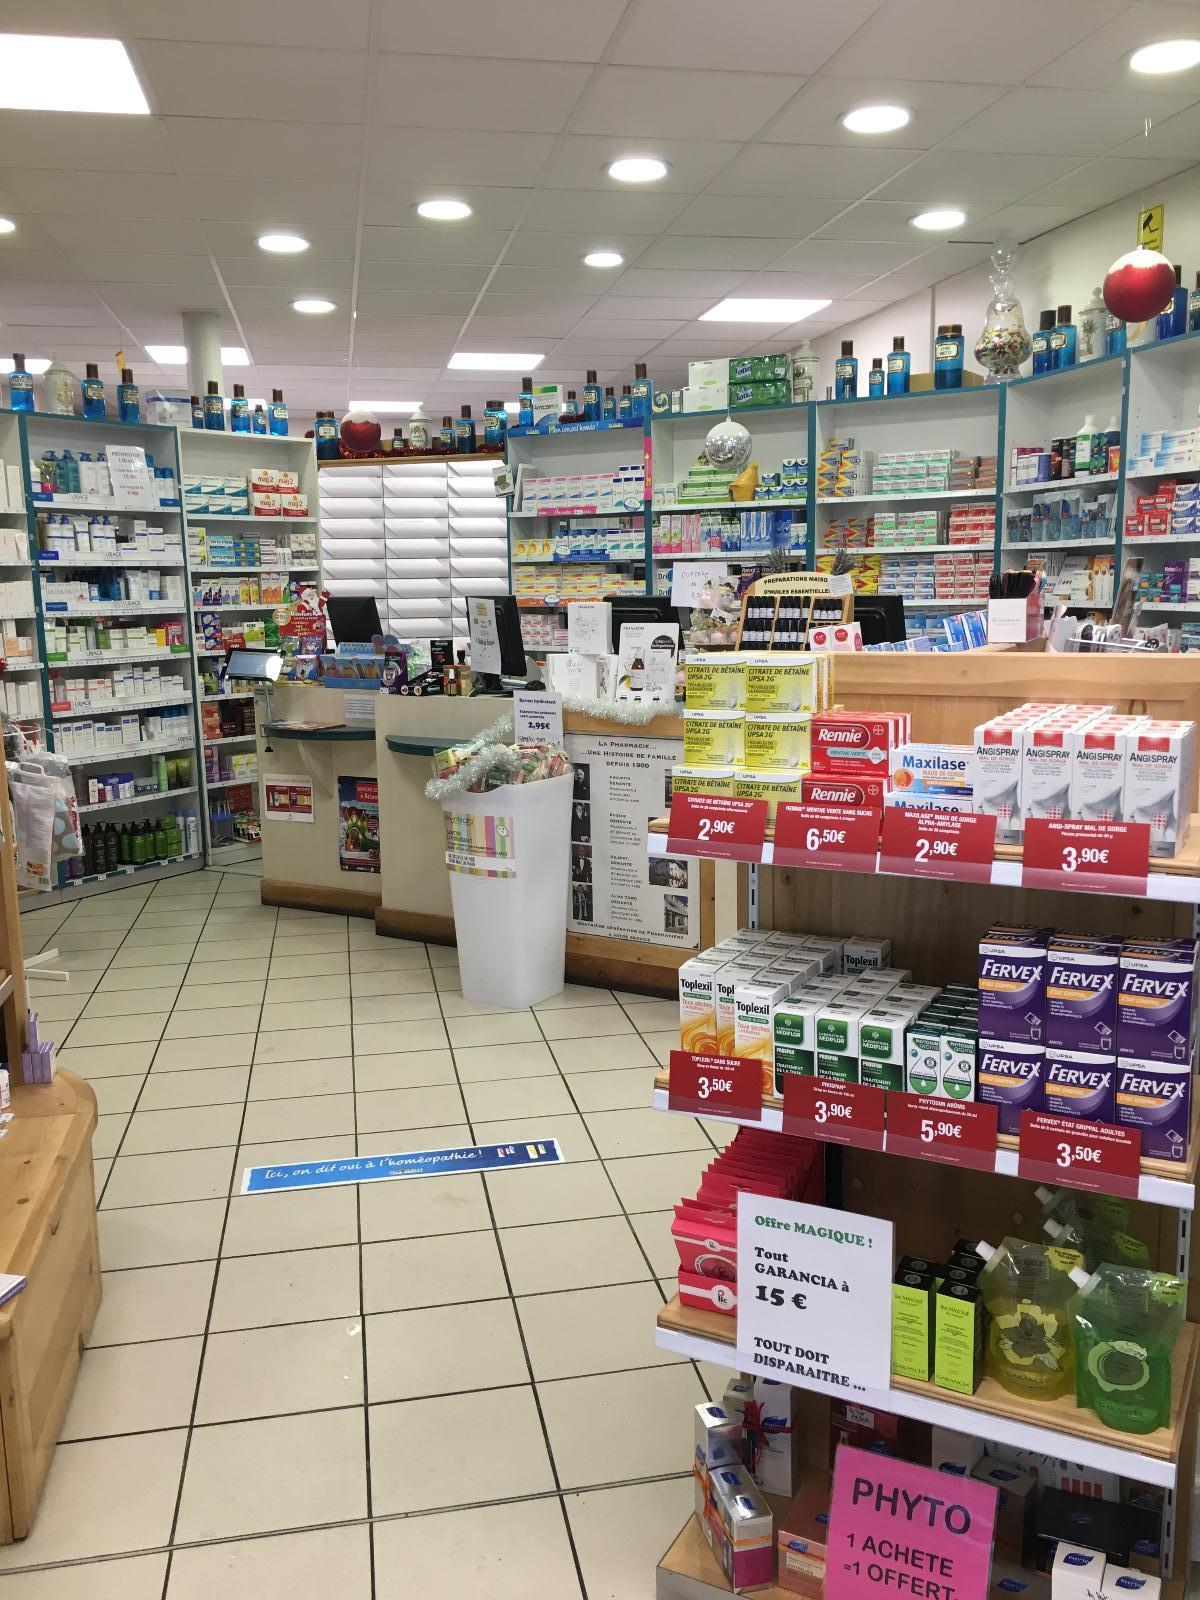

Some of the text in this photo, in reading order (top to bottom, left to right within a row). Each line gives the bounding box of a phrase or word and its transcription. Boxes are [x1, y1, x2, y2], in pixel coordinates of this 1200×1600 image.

[764, 576, 808, 584] PREPARATIONS
[688, 666, 710, 674] CITRATE
[528, 722, 550, 730] 2,95€
[818, 729, 862, 743] Rennie
[977, 746, 1020, 756] ANGISPRAY
[1026, 748, 1071, 758] ANGISPRAY
[1076, 750, 1123, 761] ANGISPRAY
[1130, 753, 1178, 764] ANGISPRAY
[903, 755, 966, 771] Maxilase
[674, 778, 697, 787] CITRATE
[736, 783, 761, 791] CITRATE
[811, 788, 856, 803] Rennie
[959, 816, 978, 824] GORGE
[1048, 823, 1083, 831] ANGI-SPRAY
[698, 818, 736, 841] 2,90€
[806, 828, 847, 851] 6,50€
[914, 839, 959, 863] 2,90€
[1062, 846, 1110, 873] 3,90€
[845, 955, 879, 968] Toplexil
[982, 959, 1043, 984] FERVEX
[1050, 967, 1115, 992] FERVEX
[680, 979, 713, 992] Toplexil
[1122, 974, 1190, 1000] FERVEX
[736, 1001, 770, 1015] Toplexil
[982, 1054, 1042, 1080] FERVEX
[1049, 1064, 1112, 1090] FERVEX
[698, 1076, 733, 1099] 3,50€
[1120, 1073, 1186, 1100] FERVEX
[919, 1098, 946, 1107] PHYTOSUN
[814, 1101, 853, 1123] 3,90€
[921, 1119, 962, 1143] 5,90€
[1062, 1120, 1075, 1128] ÉTAT
[1076, 1123, 1100, 1133] GRIPPAL
[1100, 1128, 1126, 1137] ADULTES
[1056, 1143, 1102, 1168] 3,50€
[263, 1168, 289, 1180] Ici,
[293, 1167, 313, 1176] on
[315, 1163, 337, 1175] dit
[339, 1161, 361, 1171] oui
[364, 1158, 376, 1169] à
[380, 1152, 477, 1167] l'homéopathie
[754, 1215, 873, 1249] Offre MAGIQUE !
[754, 1247, 789, 1263] Tout
[754, 1263, 850, 1293] GARANCIA à
[756, 1285, 808, 1310] 15 €
[754, 1337, 830, 1364] TOUT DOIT
[753, 1353, 850, 1387] DISPARAITRE
[1006, 1372, 1049, 1385] GARANCIA
[852, 1478, 971, 1535] PHYTO
[847, 1533, 954, 1578] 1 ACHETE
[1068, 1555, 1089, 1564] PHYTO
[1120, 1579, 1142, 1588] PHYTO
